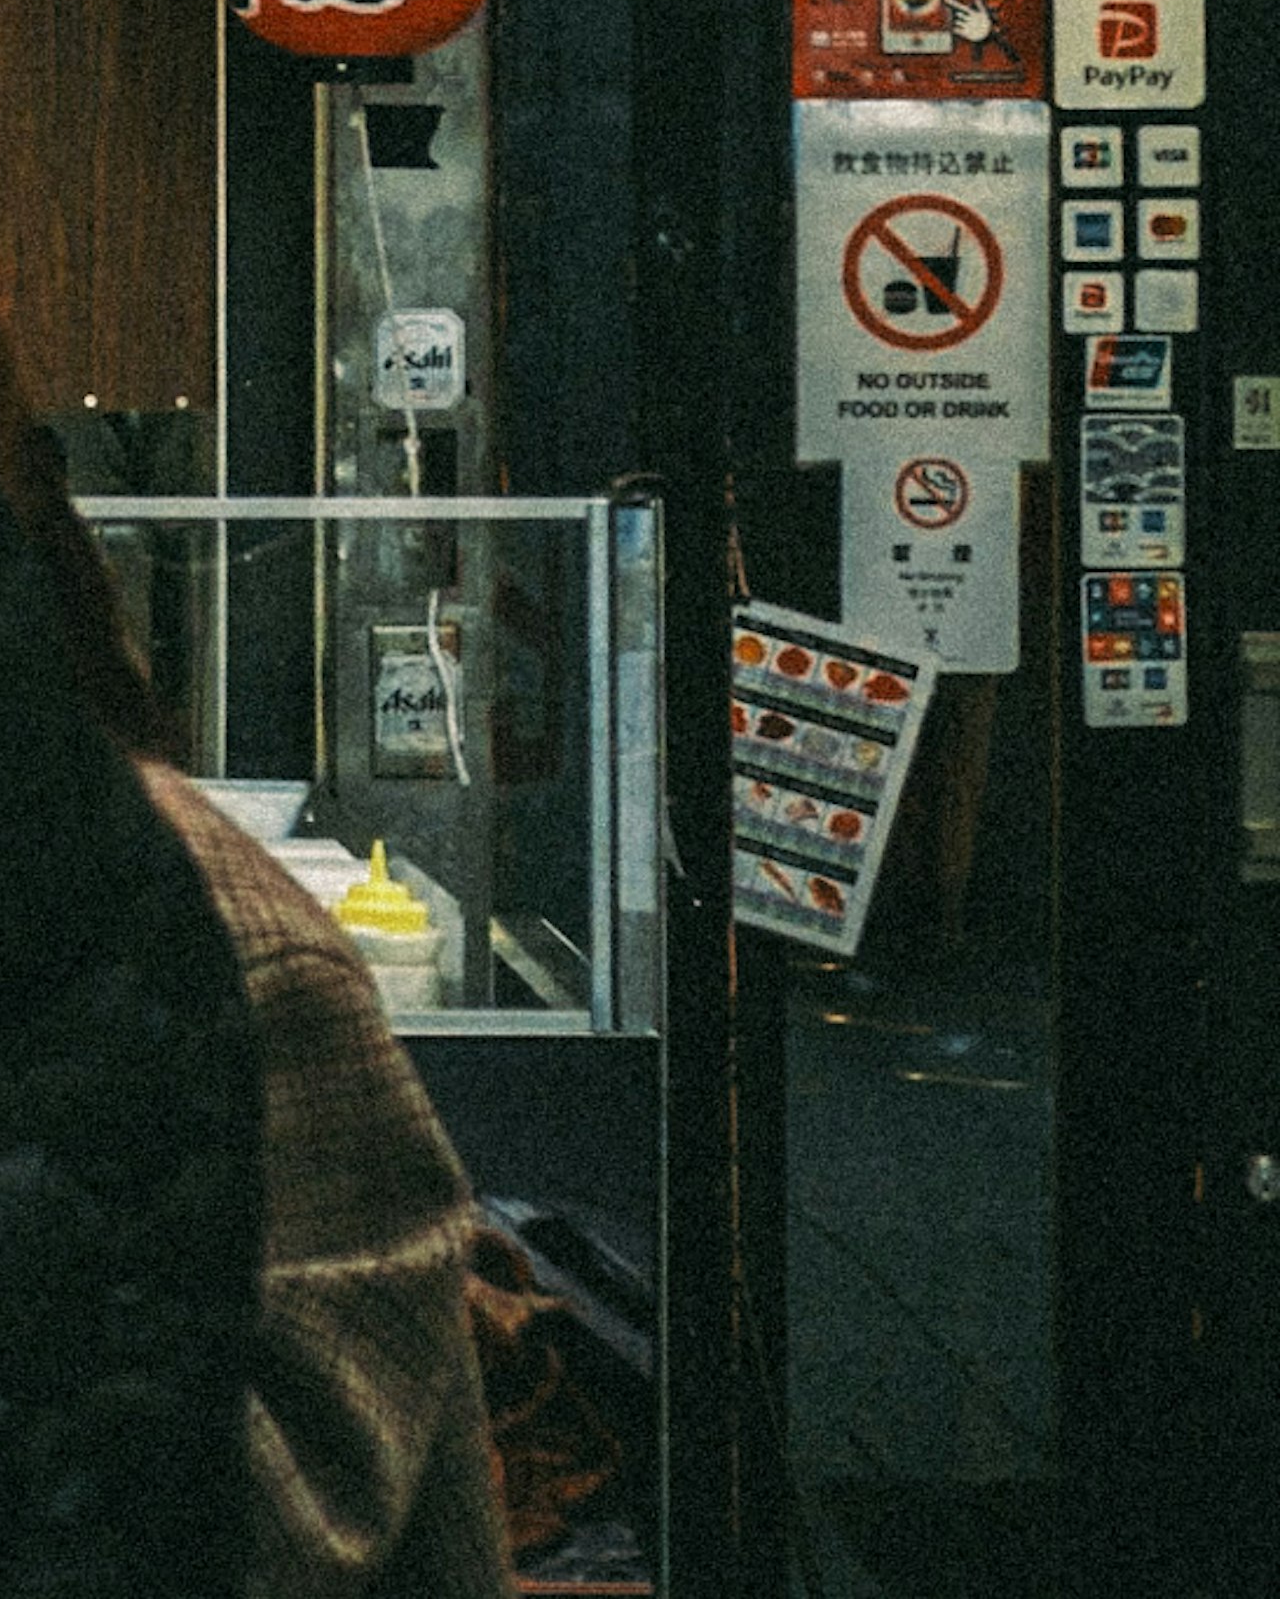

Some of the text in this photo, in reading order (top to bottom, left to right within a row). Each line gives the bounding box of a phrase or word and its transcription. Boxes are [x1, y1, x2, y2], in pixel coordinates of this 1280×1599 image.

[1084, 65, 1175, 90] PayPay
[858, 373, 991, 389] NO OUTSIDE
[838, 401, 1010, 418] FOOD OR DRINK
